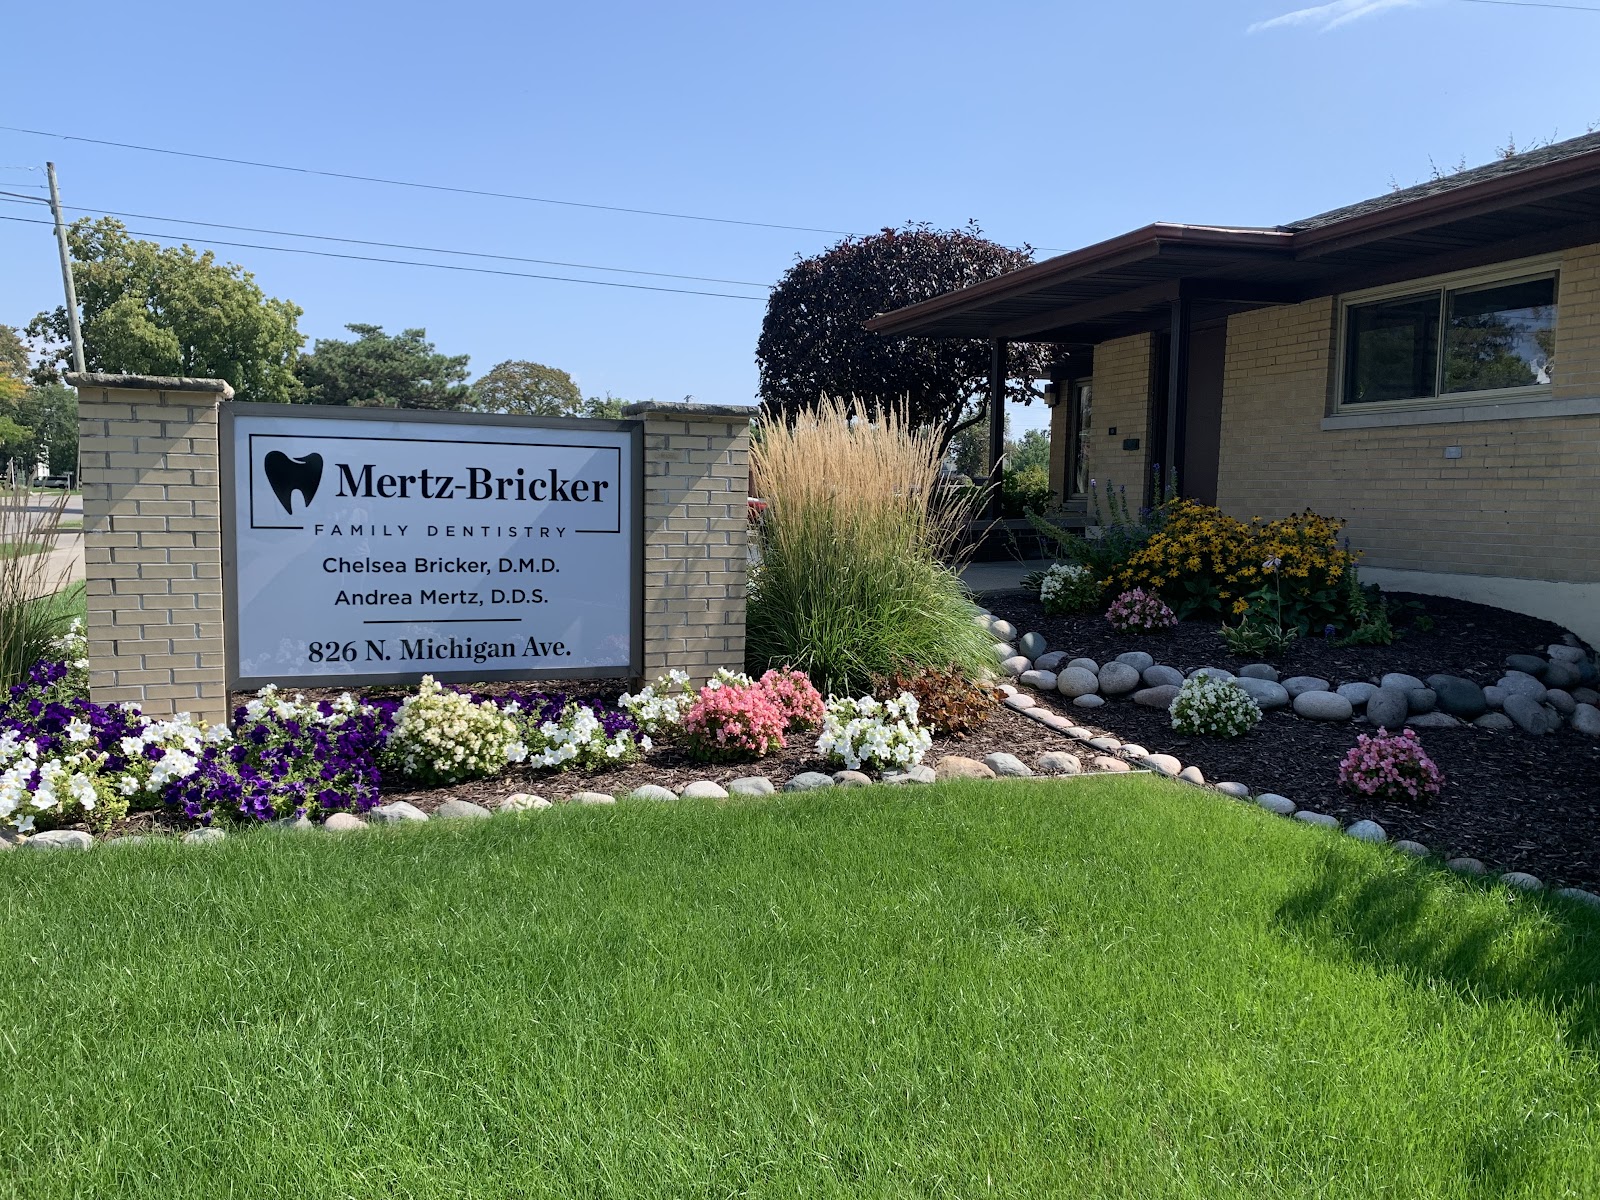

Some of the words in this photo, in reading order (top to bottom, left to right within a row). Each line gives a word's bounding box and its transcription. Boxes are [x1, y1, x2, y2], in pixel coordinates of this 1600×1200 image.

[334, 463, 609, 503] Mertz-Bricker
[314, 524, 409, 538] FAMILY
[427, 525, 567, 539] DENTISTRY
[322, 556, 407, 574] Chelsea
[414, 557, 491, 576] Bricker,
[498, 557, 560, 573] D.M.D.
[334, 589, 413, 606] Andrea
[420, 589, 484, 607] Mertz,
[491, 588, 549, 604] D.D.S.
[308, 640, 358, 663] 826
[364, 639, 391, 662] N.
[399, 637, 517, 664] Michigan
[521, 636, 572, 658] Ave.
